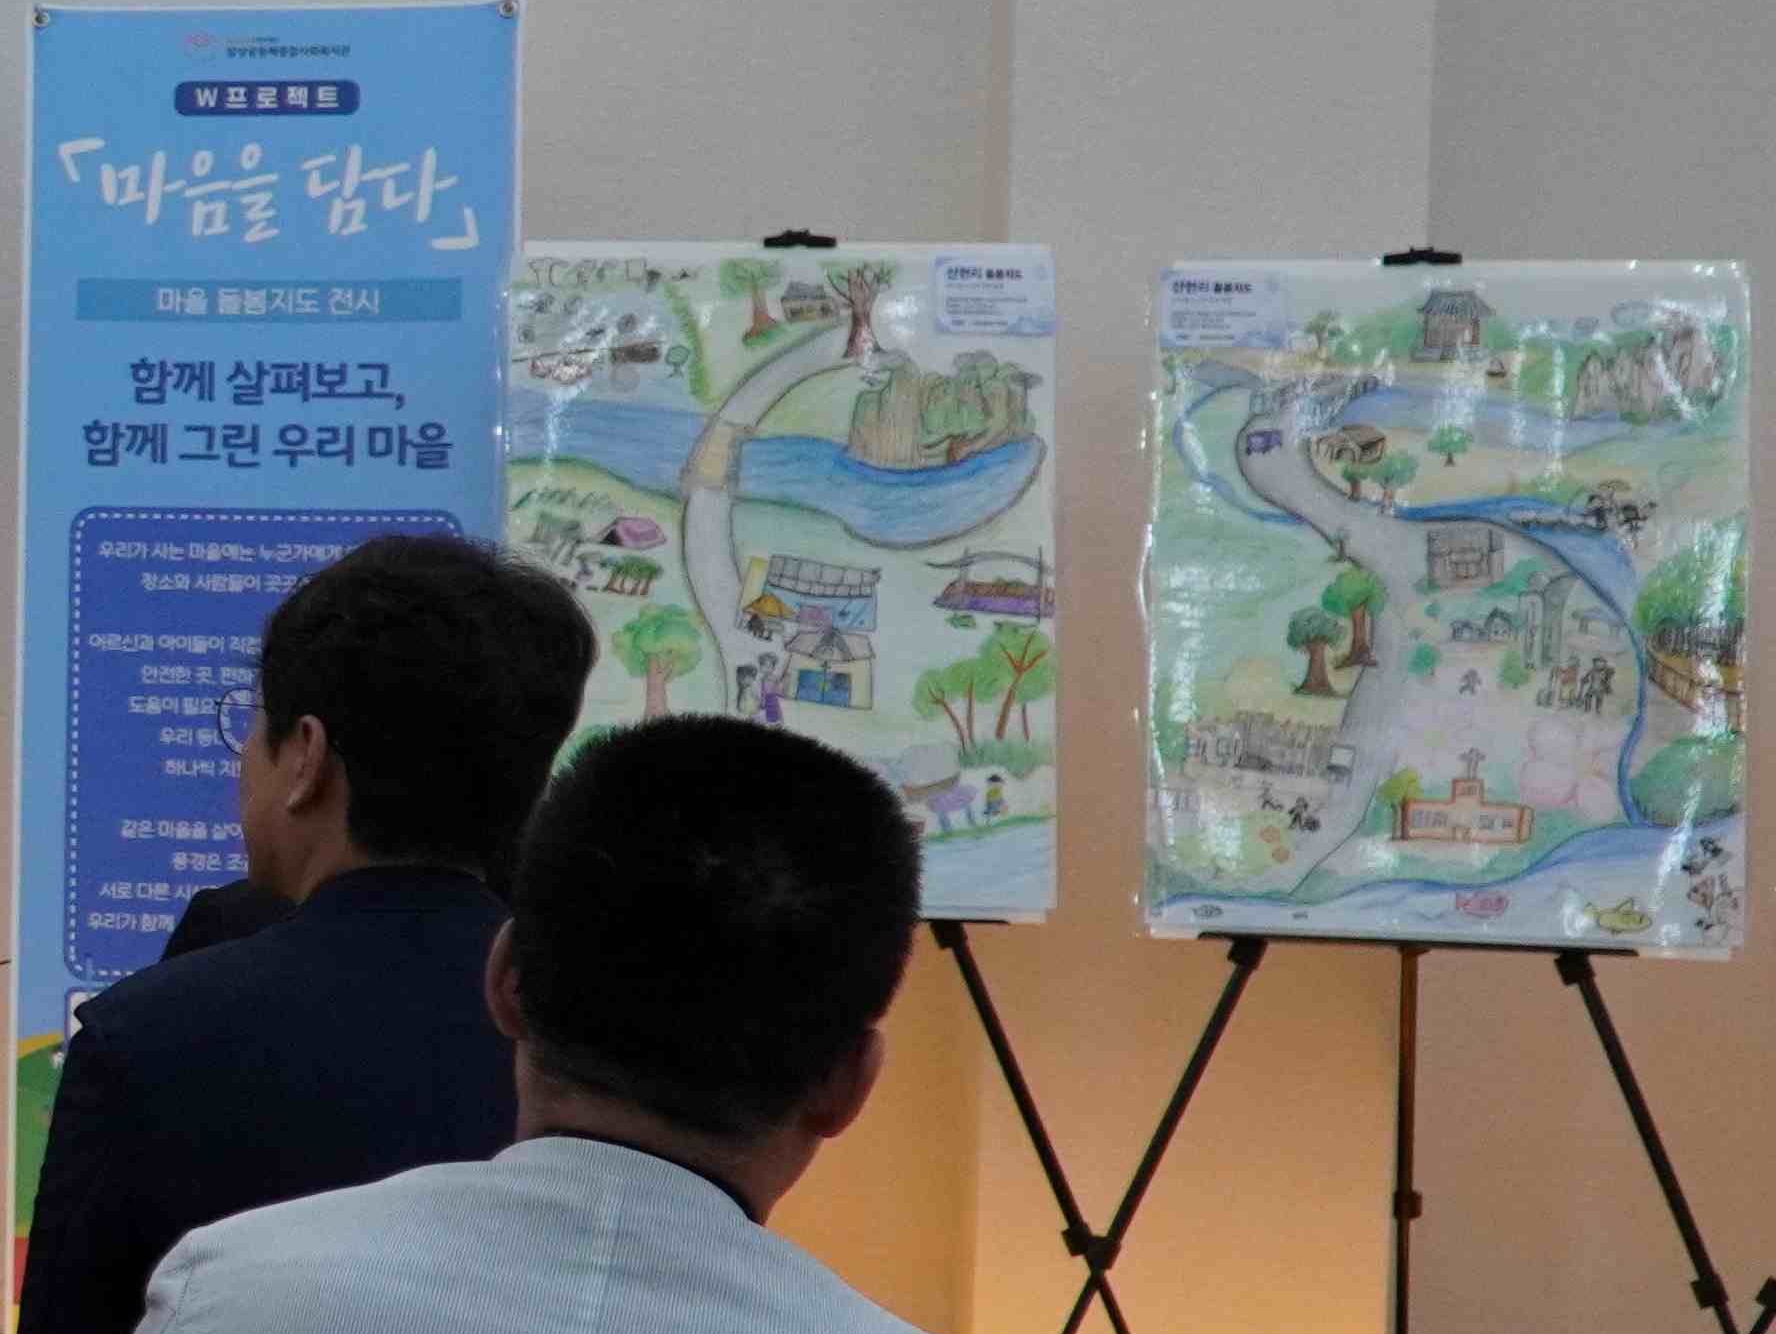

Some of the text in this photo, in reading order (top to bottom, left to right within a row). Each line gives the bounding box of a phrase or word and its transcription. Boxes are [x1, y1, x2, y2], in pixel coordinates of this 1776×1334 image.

[328, 287, 380, 315] 전시
[130, 357, 406, 410] 함께 살펴보고,
[82, 419, 454, 469] 함께 그린 우리 마을
[159, 726, 193, 746] 우리
[98, 881, 134, 900] 서로
[137, 881, 171, 901] 다른
[87, 911, 138, 931] 우리가
